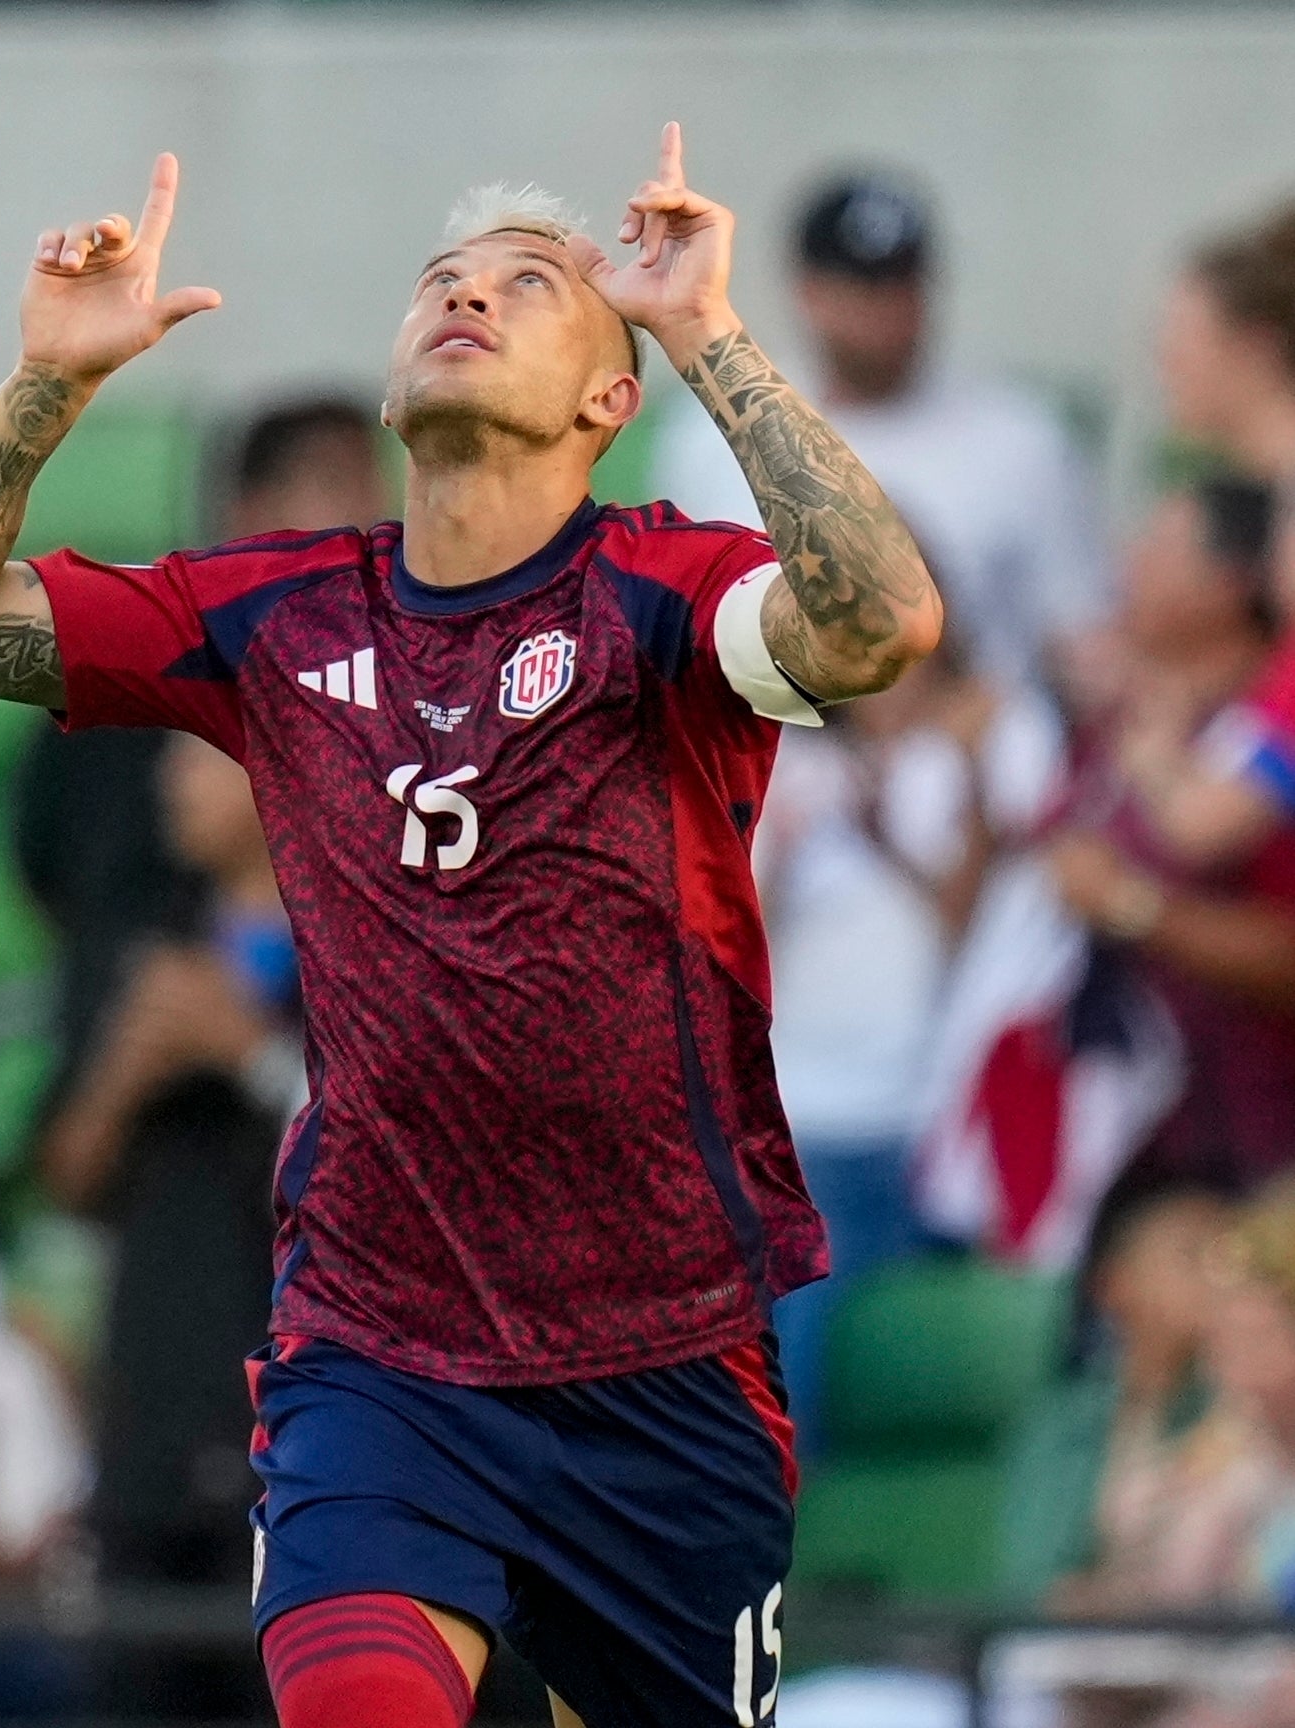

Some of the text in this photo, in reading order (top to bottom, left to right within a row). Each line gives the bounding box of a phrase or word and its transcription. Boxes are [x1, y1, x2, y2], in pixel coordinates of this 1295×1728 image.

[518, 649, 559, 704] CR
[386, 764, 479, 871] 15
[733, 1581, 782, 1728] 15
